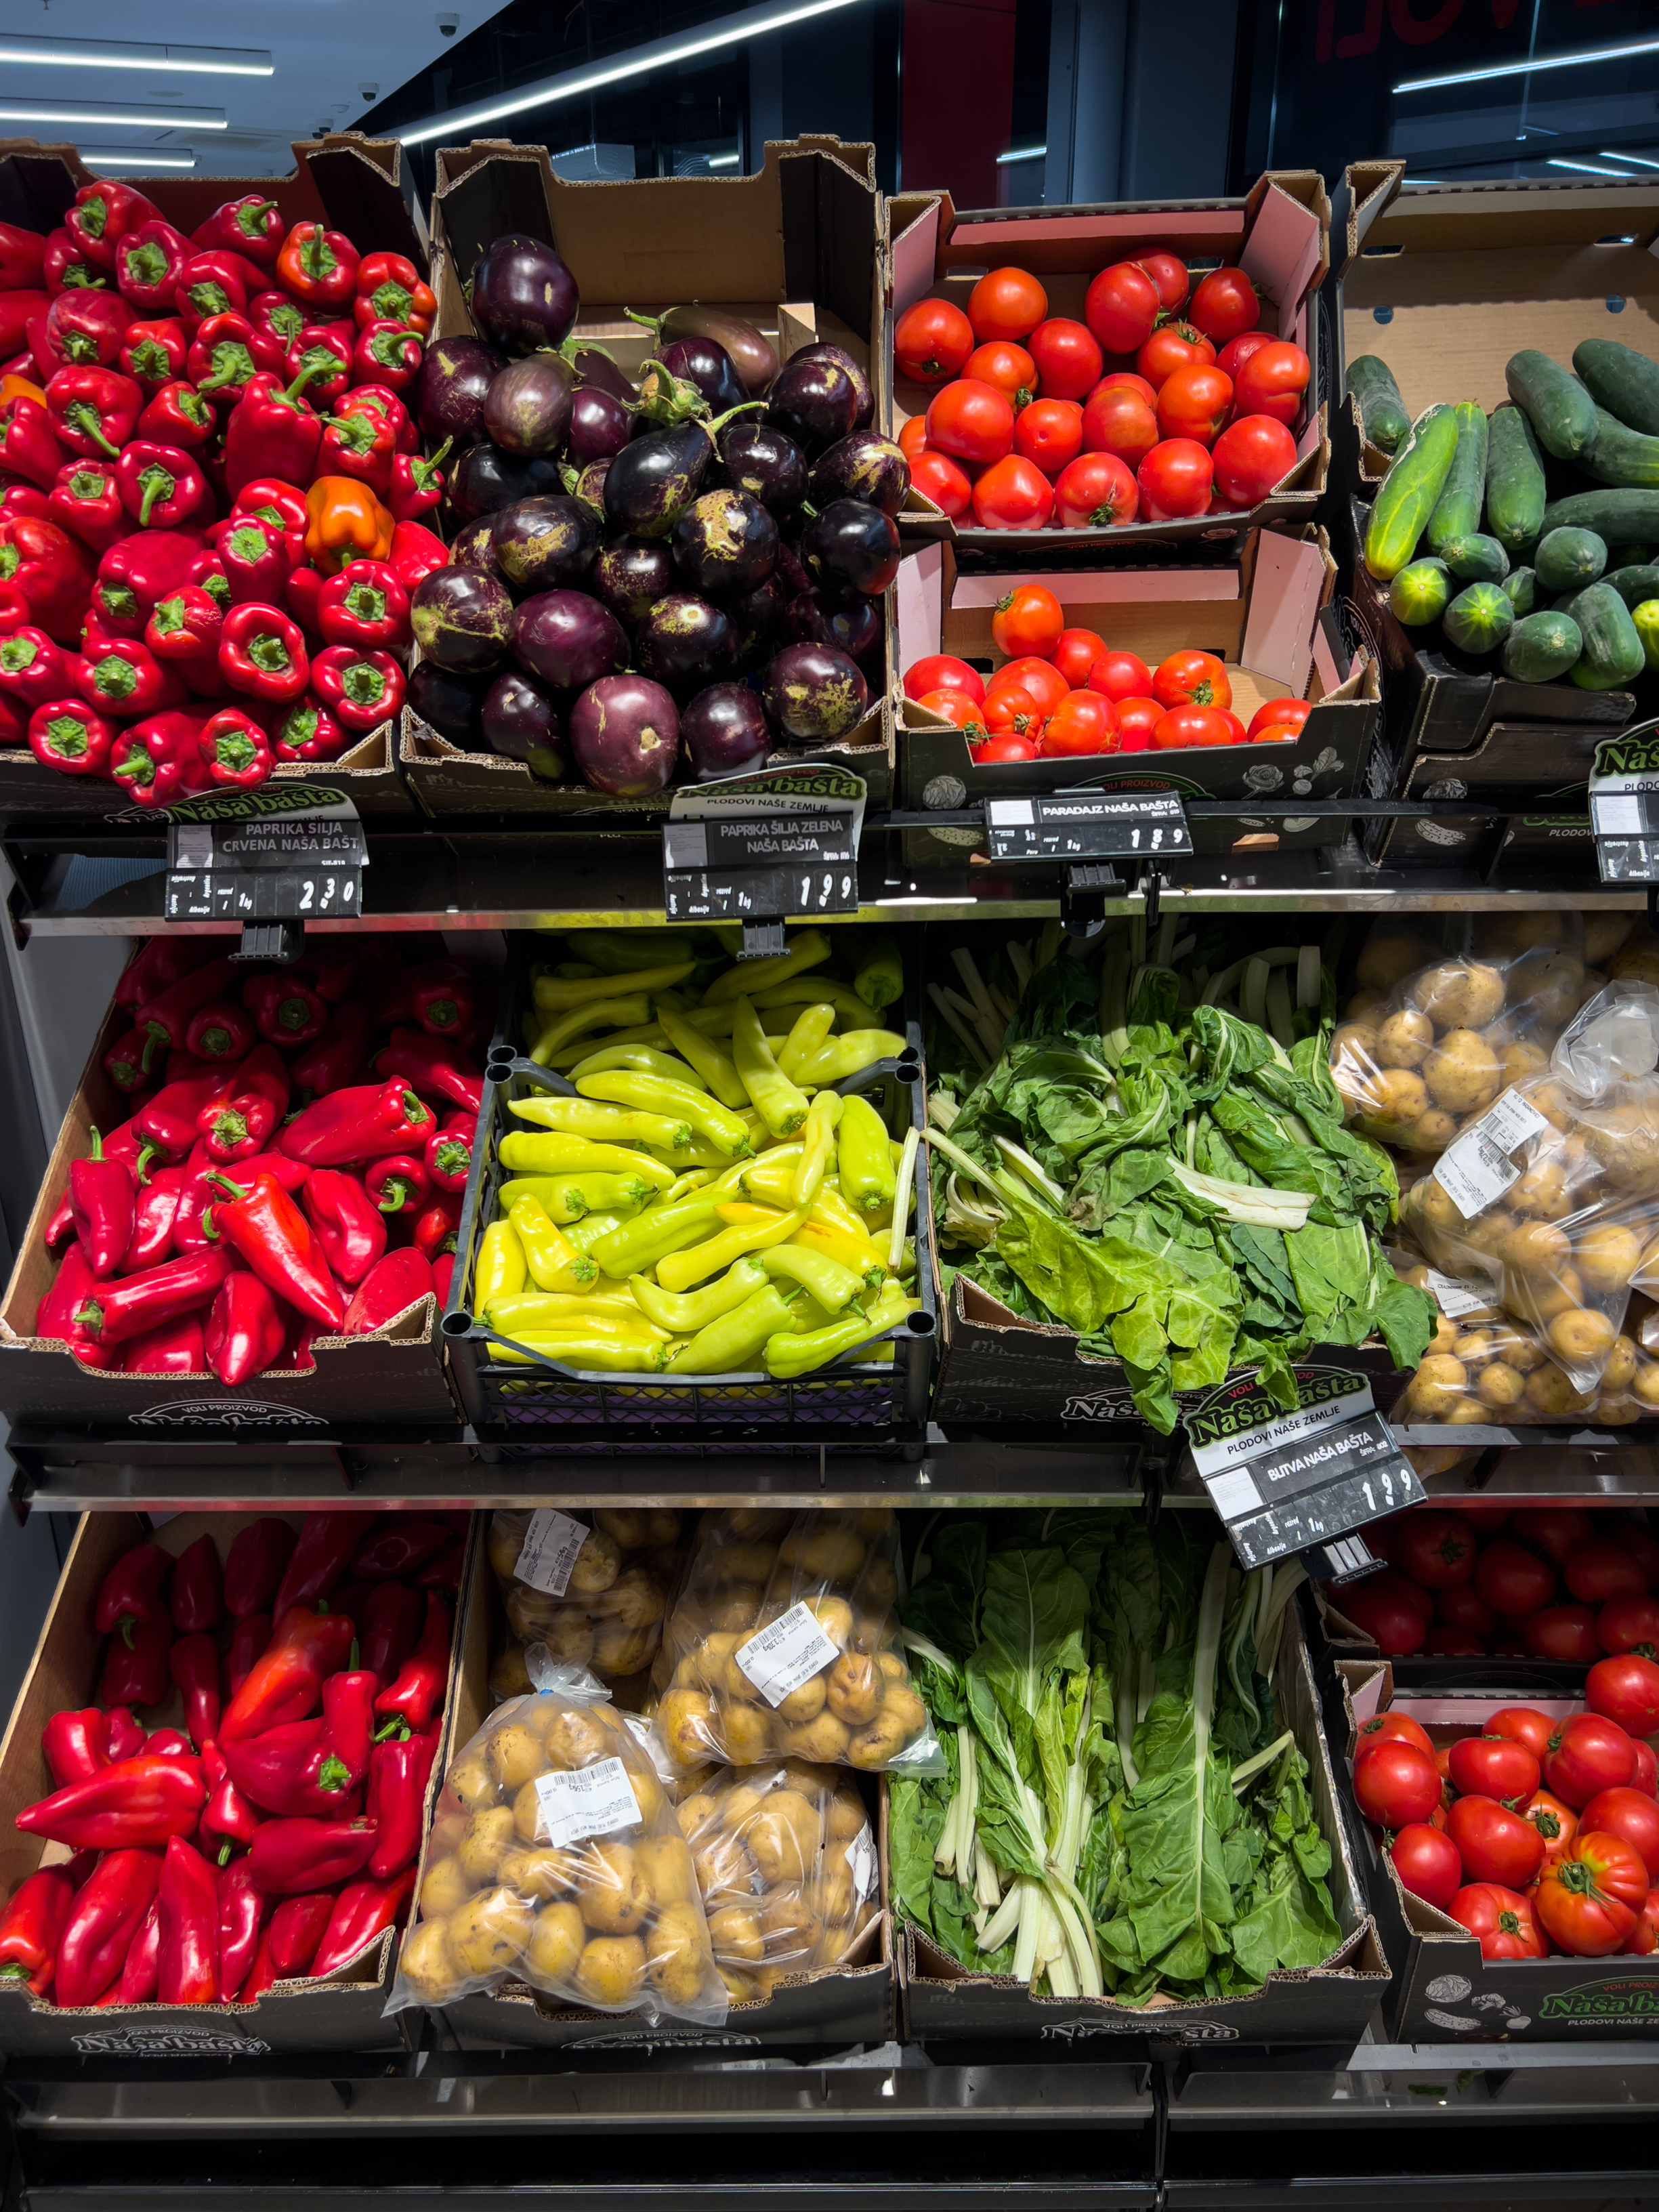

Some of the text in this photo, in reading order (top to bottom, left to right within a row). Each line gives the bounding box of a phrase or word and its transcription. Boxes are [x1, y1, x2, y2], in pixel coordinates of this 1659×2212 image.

[774, 778, 858, 797] bašta
[1103, 779, 1171, 791] OLI PROIZVOD
[170, 789, 340, 822] Naša bašta
[758, 798, 786, 808] NAŠE
[790, 801, 828, 813] ZEMLJE
[1043, 805, 1104, 816] PARADAJZ
[1105, 802, 1139, 813] NAŠA
[1139, 799, 1179, 812] BAŠTA
[246, 823, 305, 835] PAPRIKA
[721, 823, 769, 837] PAPRIKA
[801, 819, 843, 833] ZELENA
[223, 835, 360, 852] CRVENA NAŠA BAŠT
[747, 837, 819, 853] NAŠA BAŠTA
[217, 887, 234, 895] razred
[188, 906, 211, 915] Albanija
[1227, 1382, 1254, 1399] VOLI
[182, 1404, 268, 1413] VOLI PROIZVOD
[1068, 1399, 1141, 1418] Naš
[1192, 1401, 1272, 1443] Naša
[1227, 1405, 1341, 1455] PLODOVI NAŠE ZEMLJE
[1303, 1446, 1338, 1467] NAŠA
[1335, 1432, 1374, 1455] BAŠTA
[1284, 1516, 1300, 1528] razred
[1266, 1542, 1287, 1555] Albanija
[1603, 1982, 1626, 1992] VOLI
[1550, 1998, 1624, 2013] Naša
[150, 2028, 210, 2037] PROIZVOD
